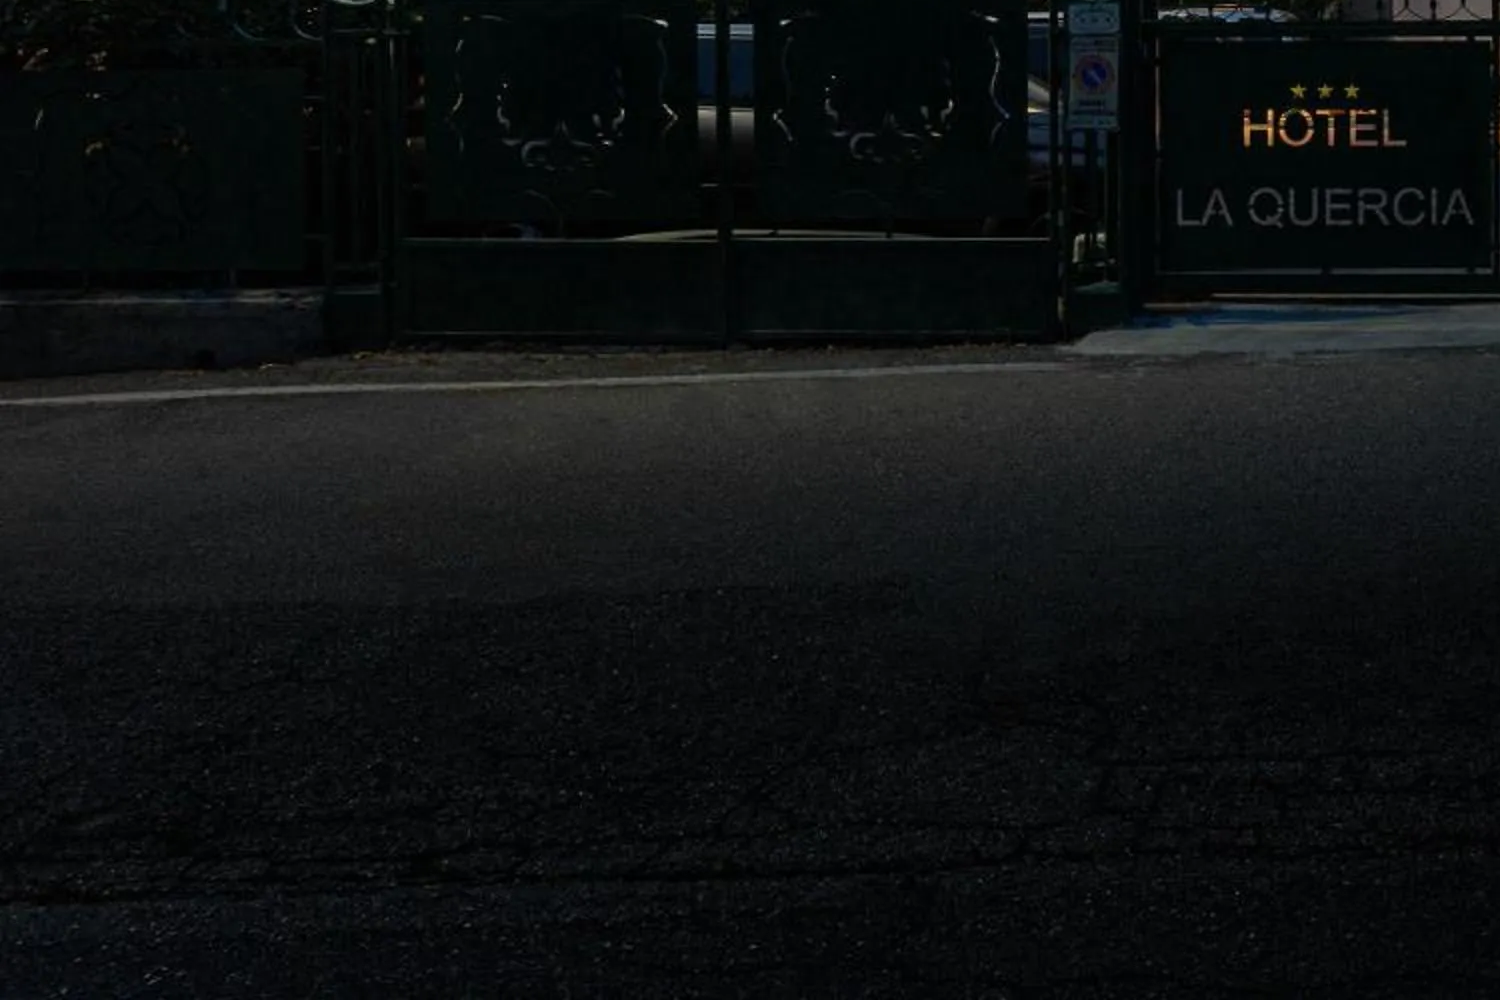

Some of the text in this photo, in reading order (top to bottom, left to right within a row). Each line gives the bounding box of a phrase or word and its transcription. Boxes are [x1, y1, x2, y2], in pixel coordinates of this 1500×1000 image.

[1241, 107, 1408, 148] HOTEL
[1175, 186, 1476, 229] LA QUERCIA
